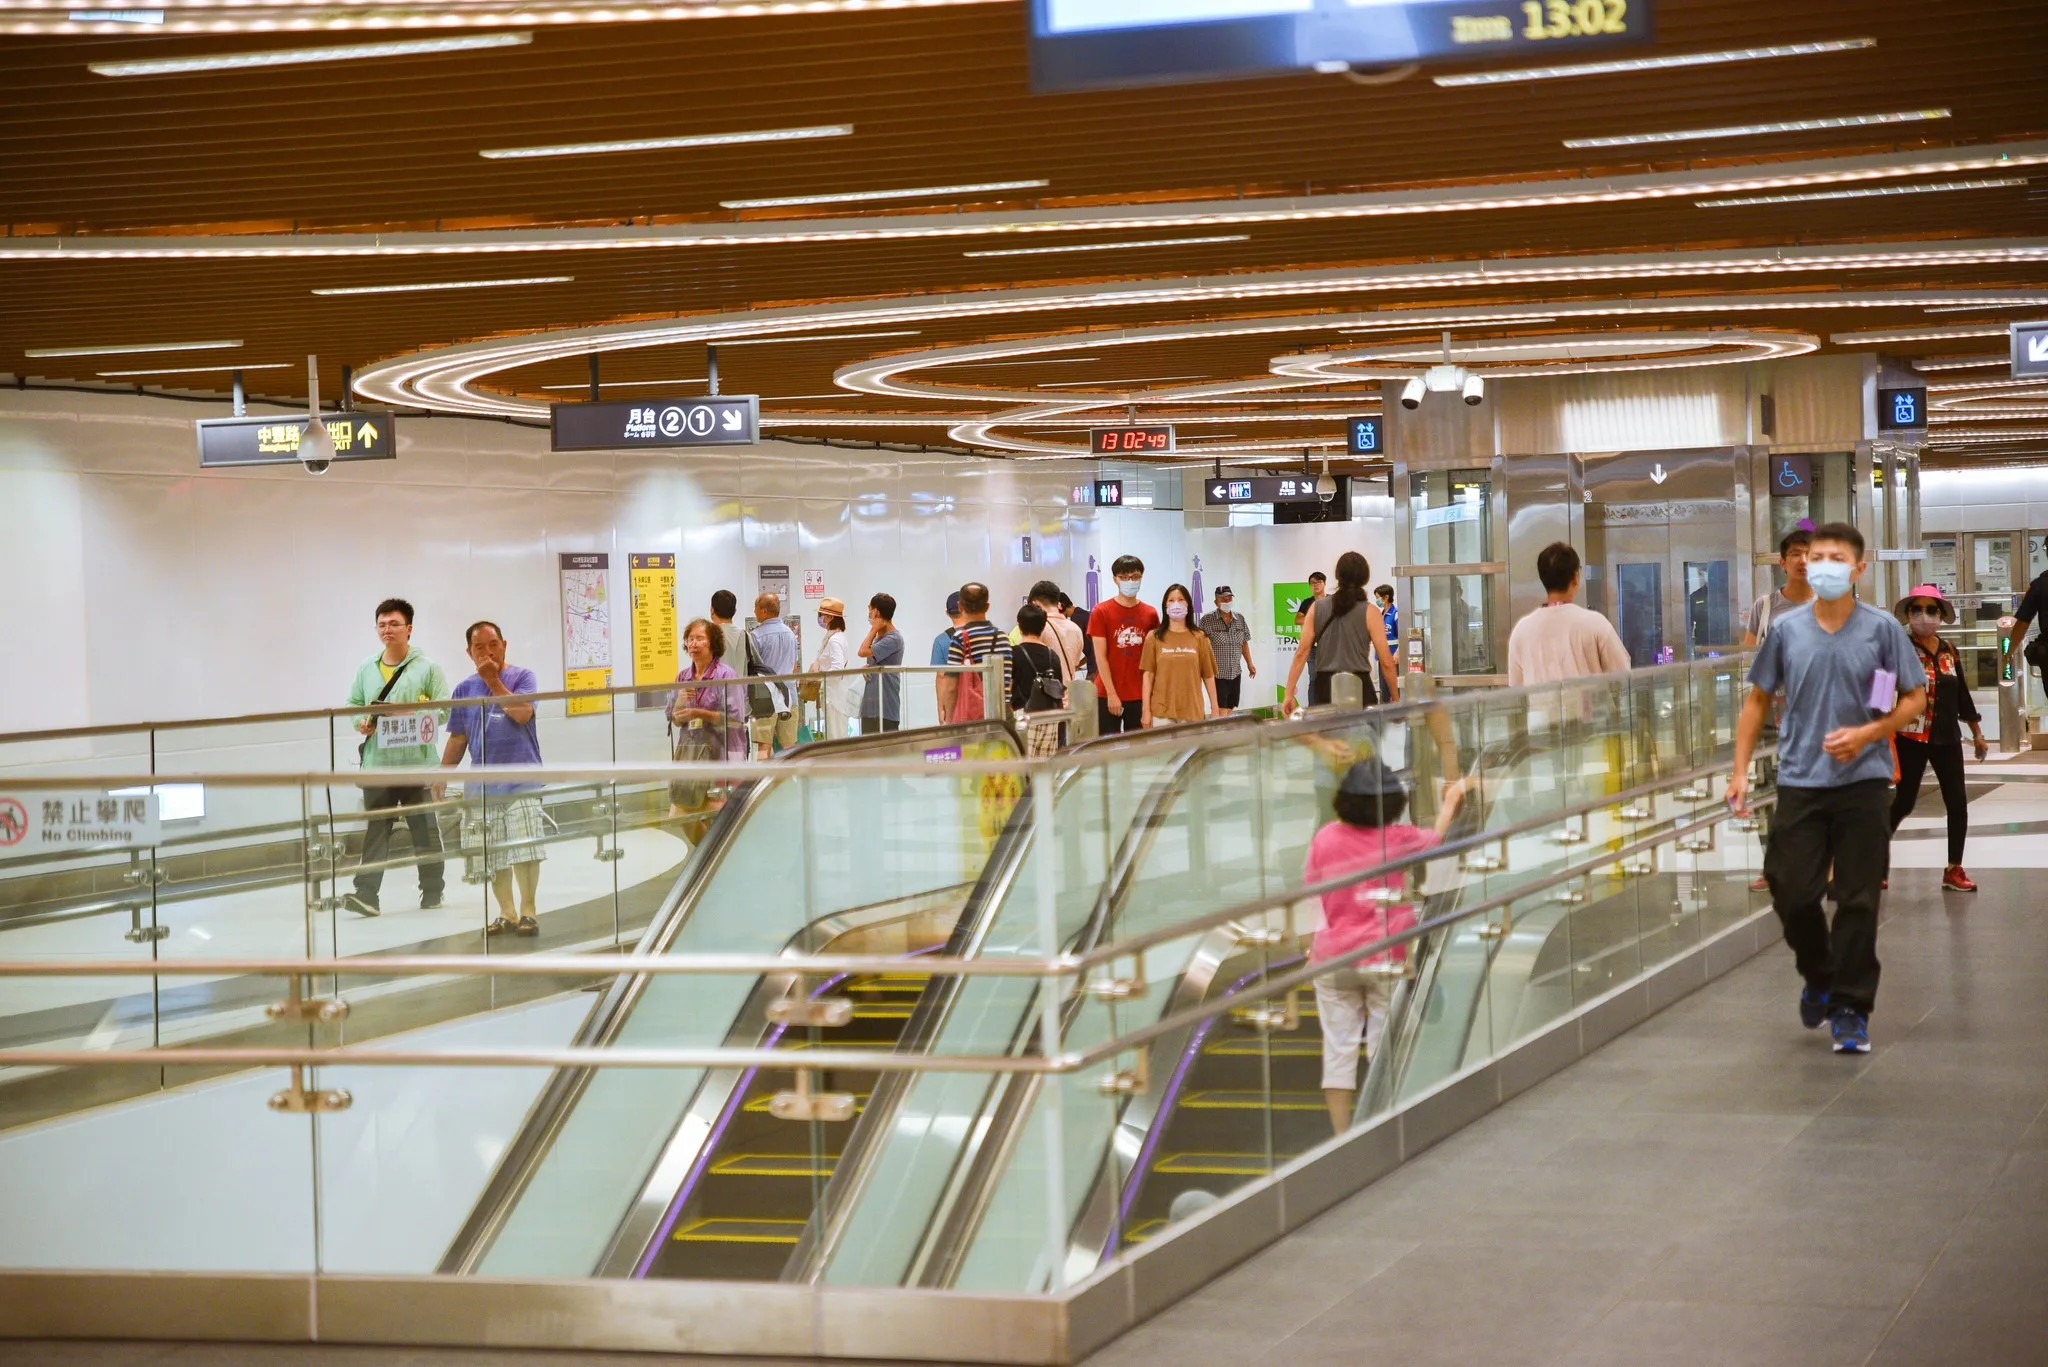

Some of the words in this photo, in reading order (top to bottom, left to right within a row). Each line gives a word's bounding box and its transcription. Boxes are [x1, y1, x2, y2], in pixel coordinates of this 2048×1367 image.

[1522, 0, 1627, 40] 13:02
[629, 408, 656, 424] 月台
[326, 421, 352, 441] 出口
[626, 424, 656, 433] Platform
[1101, 432, 1119, 450] 13
[1122, 432, 1146, 449] 02
[1147, 434, 1167, 448] 49
[1584, 490, 1593, 503] 2
[42, 799, 146, 826] 禁止攀爬
[42, 829, 62, 842] No
[66, 828, 132, 843] Climbing
